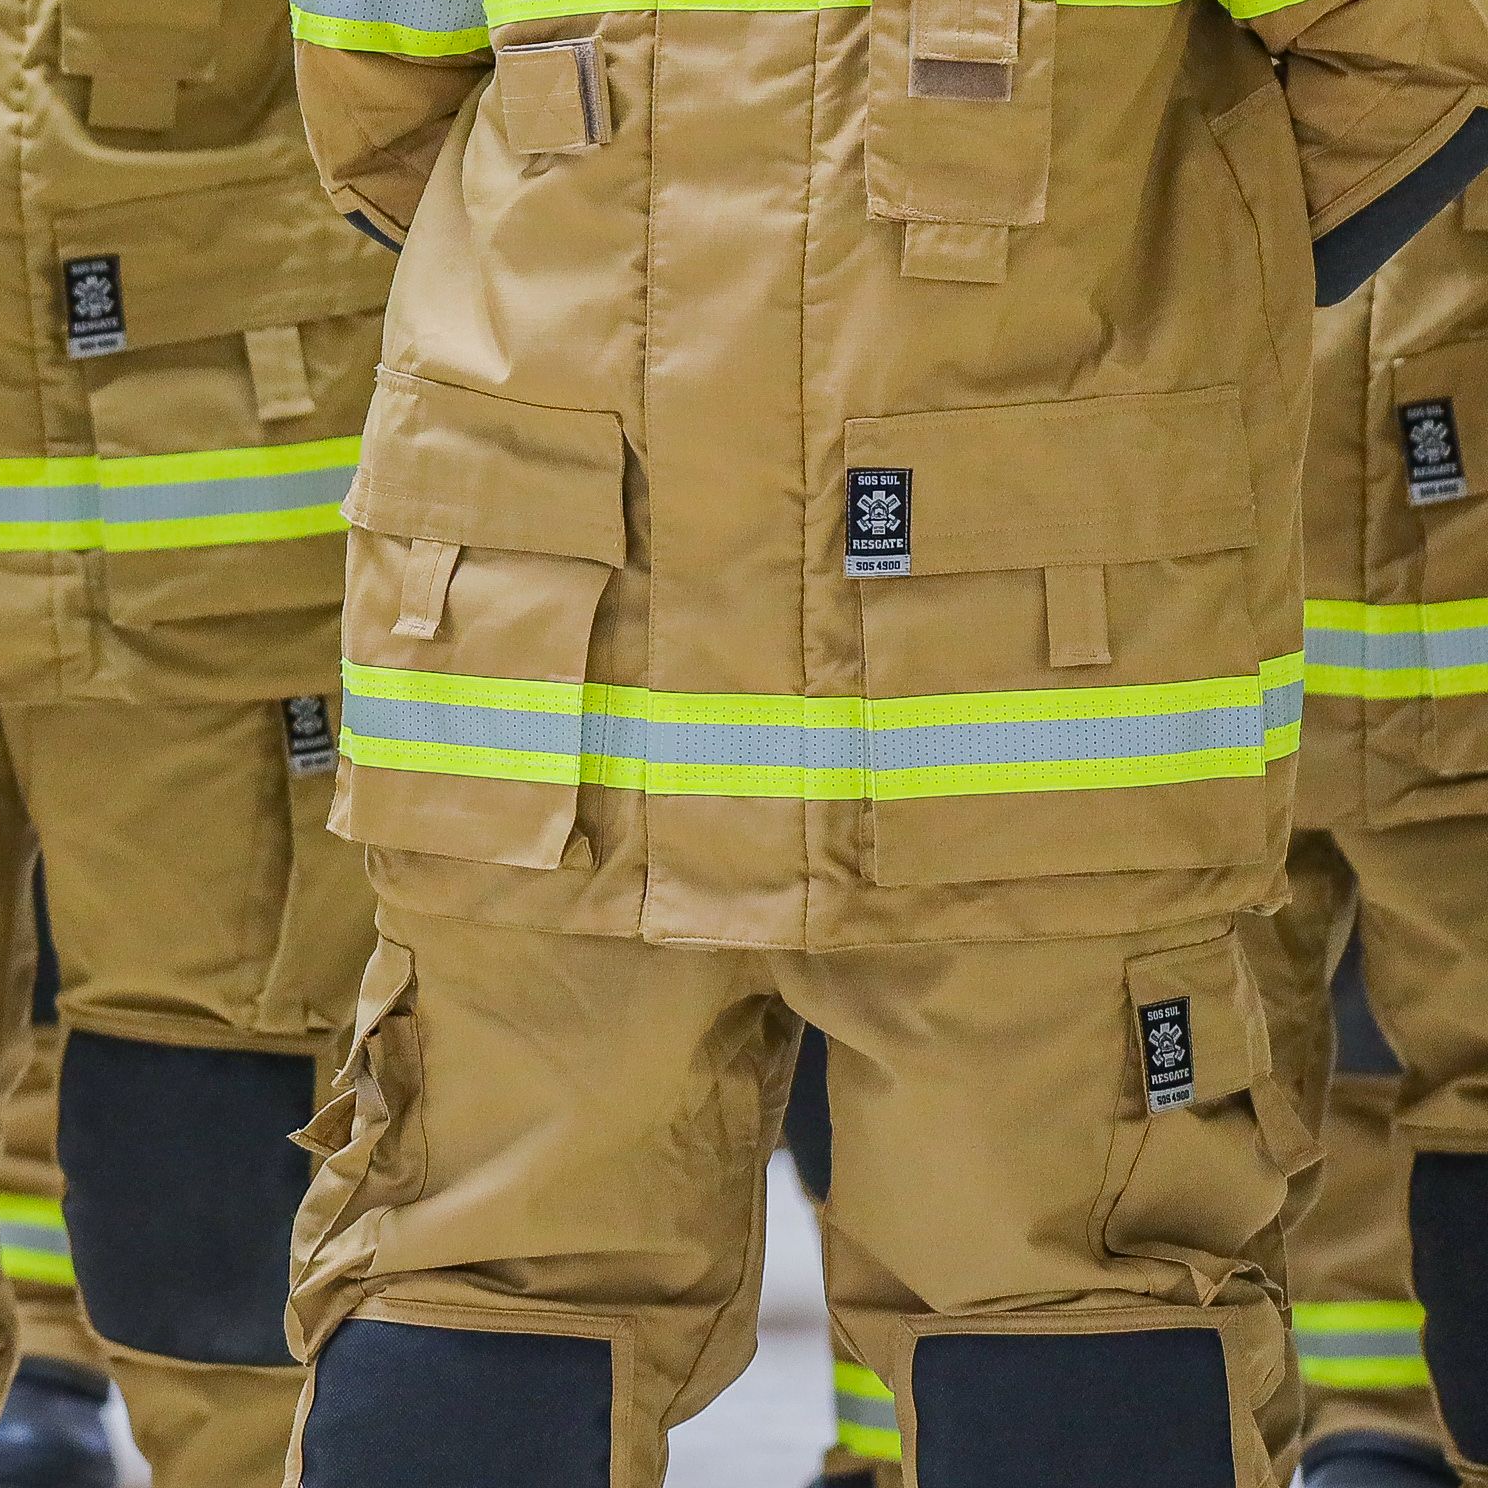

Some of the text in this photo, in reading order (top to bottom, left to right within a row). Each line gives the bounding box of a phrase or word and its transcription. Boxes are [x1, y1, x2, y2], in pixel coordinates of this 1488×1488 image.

[858, 475, 900, 485] SOS SUL
[852, 538, 904, 550] RESGATE
[856, 560, 901, 571] SOS 4900
[1147, 1006, 1180, 1021] SOS SUL
[1151, 1068, 1190, 1085] RESGATE
[1156, 1093, 1171, 1106] SOS
